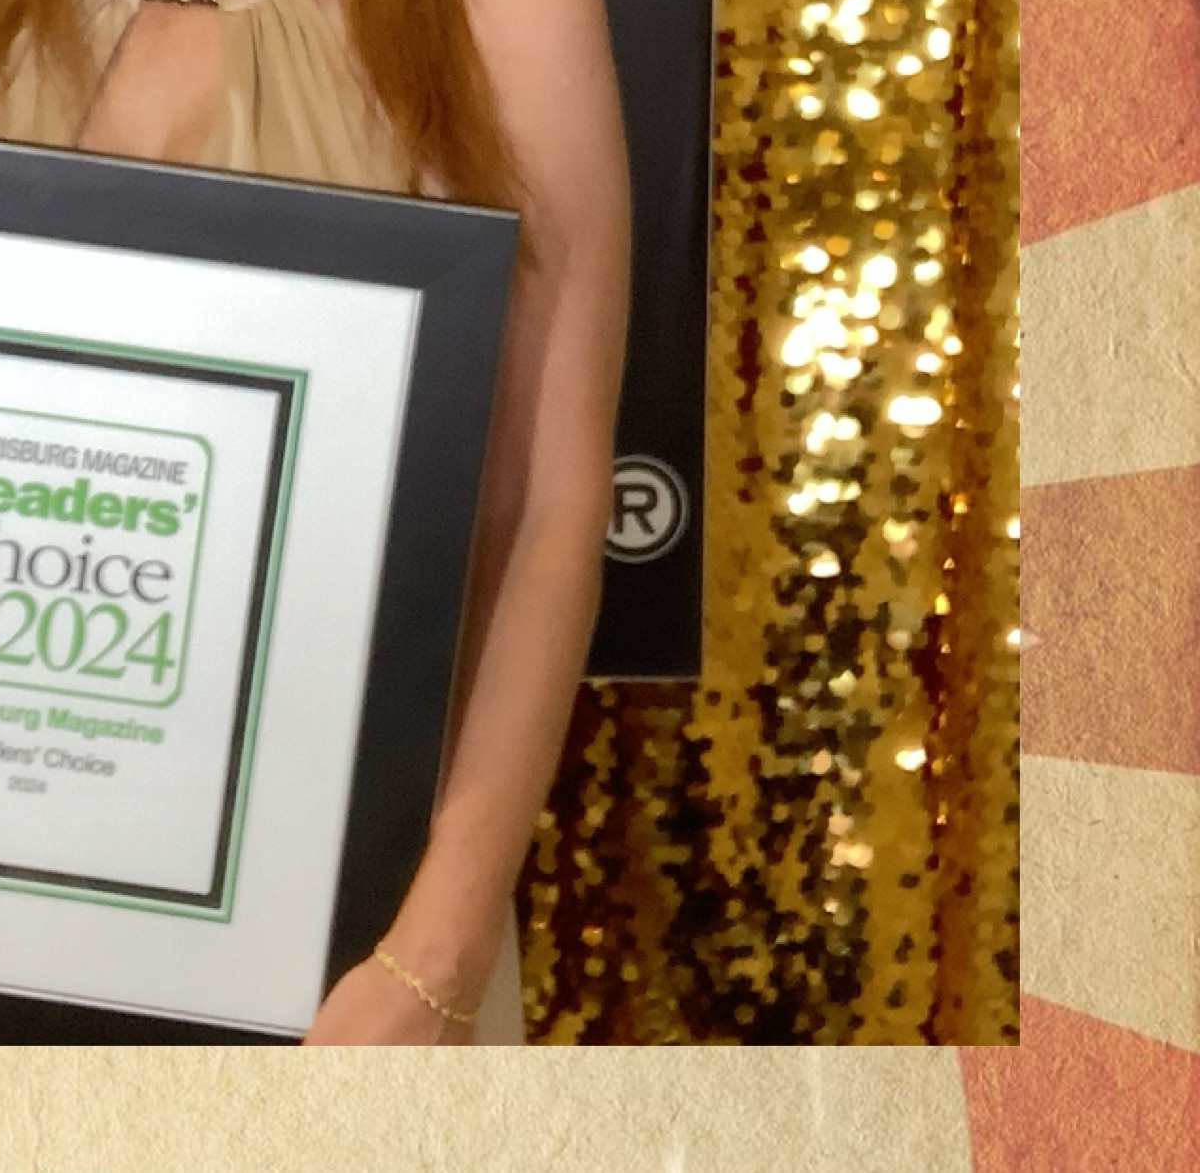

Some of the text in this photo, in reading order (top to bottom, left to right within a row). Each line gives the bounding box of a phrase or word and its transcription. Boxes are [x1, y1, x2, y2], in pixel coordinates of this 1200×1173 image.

[82, 448, 188, 485] MAGAZINE
[47, 707, 165, 744] Magazine
[43, 747, 117, 777] Choice
